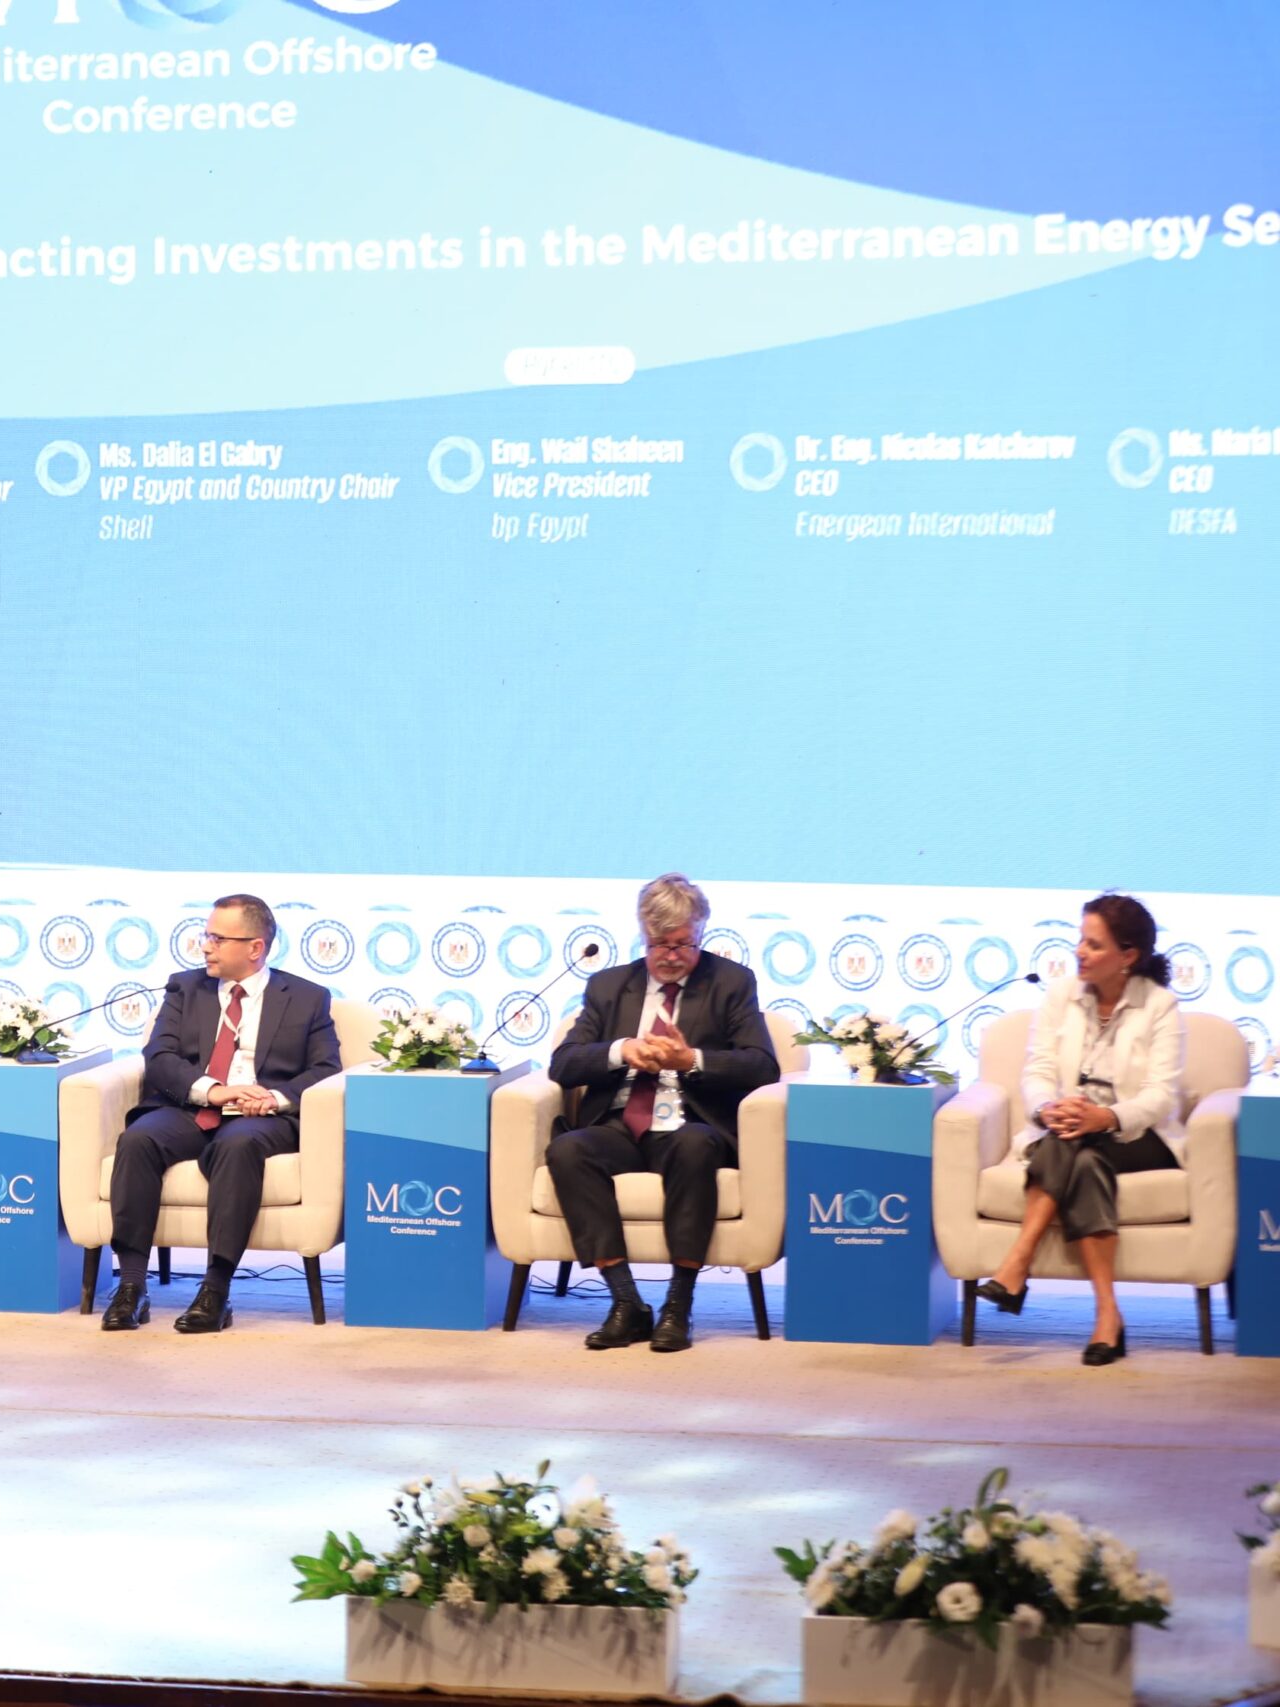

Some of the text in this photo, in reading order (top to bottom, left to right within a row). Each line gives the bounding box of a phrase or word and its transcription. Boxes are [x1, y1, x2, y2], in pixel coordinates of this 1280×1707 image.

[244, 36, 437, 75] Offshore
[42, 96, 297, 134] Conference
[154, 232, 464, 274] Investments
[479, 226, 527, 268] in
[541, 226, 626, 266] the
[643, 219, 1019, 264] Mediterranean
[1034, 213, 1211, 261] Energy
[99, 443, 137, 468] Ms.
[142, 441, 194, 468] Dalia
[198, 441, 217, 467] El
[491, 438, 537, 468] Eng.
[100, 472, 401, 505] VP Egypt and Country Chair
[492, 470, 652, 499] Vice President
[795, 469, 840, 497] CEO
[1169, 464, 1214, 493] CEO
[99, 514, 154, 541] Shell
[0, 1206, 34, 1214] Offshore
[366, 1180, 462, 1216] MOC
[809, 1189, 909, 1225] MOC
